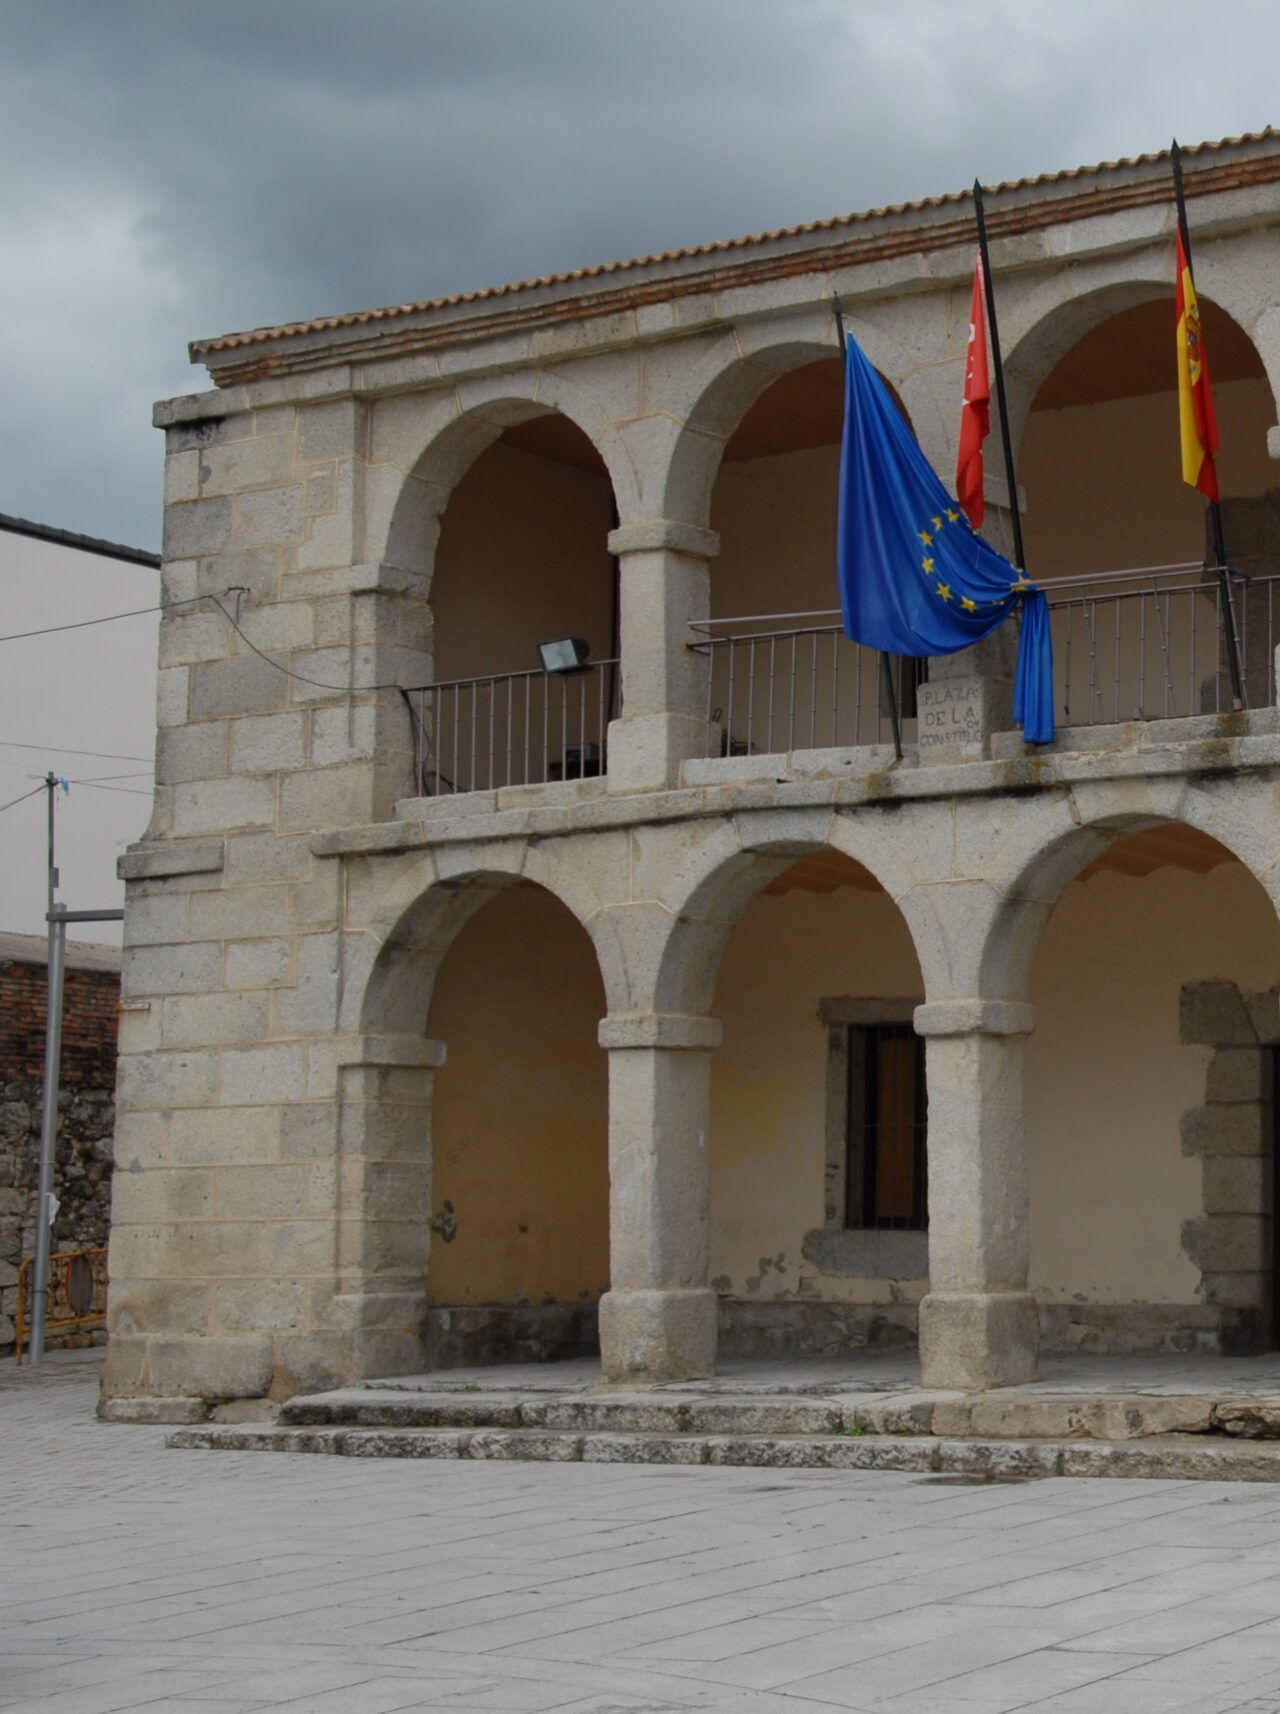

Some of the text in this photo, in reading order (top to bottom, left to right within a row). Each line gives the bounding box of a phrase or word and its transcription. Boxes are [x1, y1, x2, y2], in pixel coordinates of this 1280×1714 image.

[924, 687, 977, 705] PLAZA
[925, 706, 975, 726] DE LA
